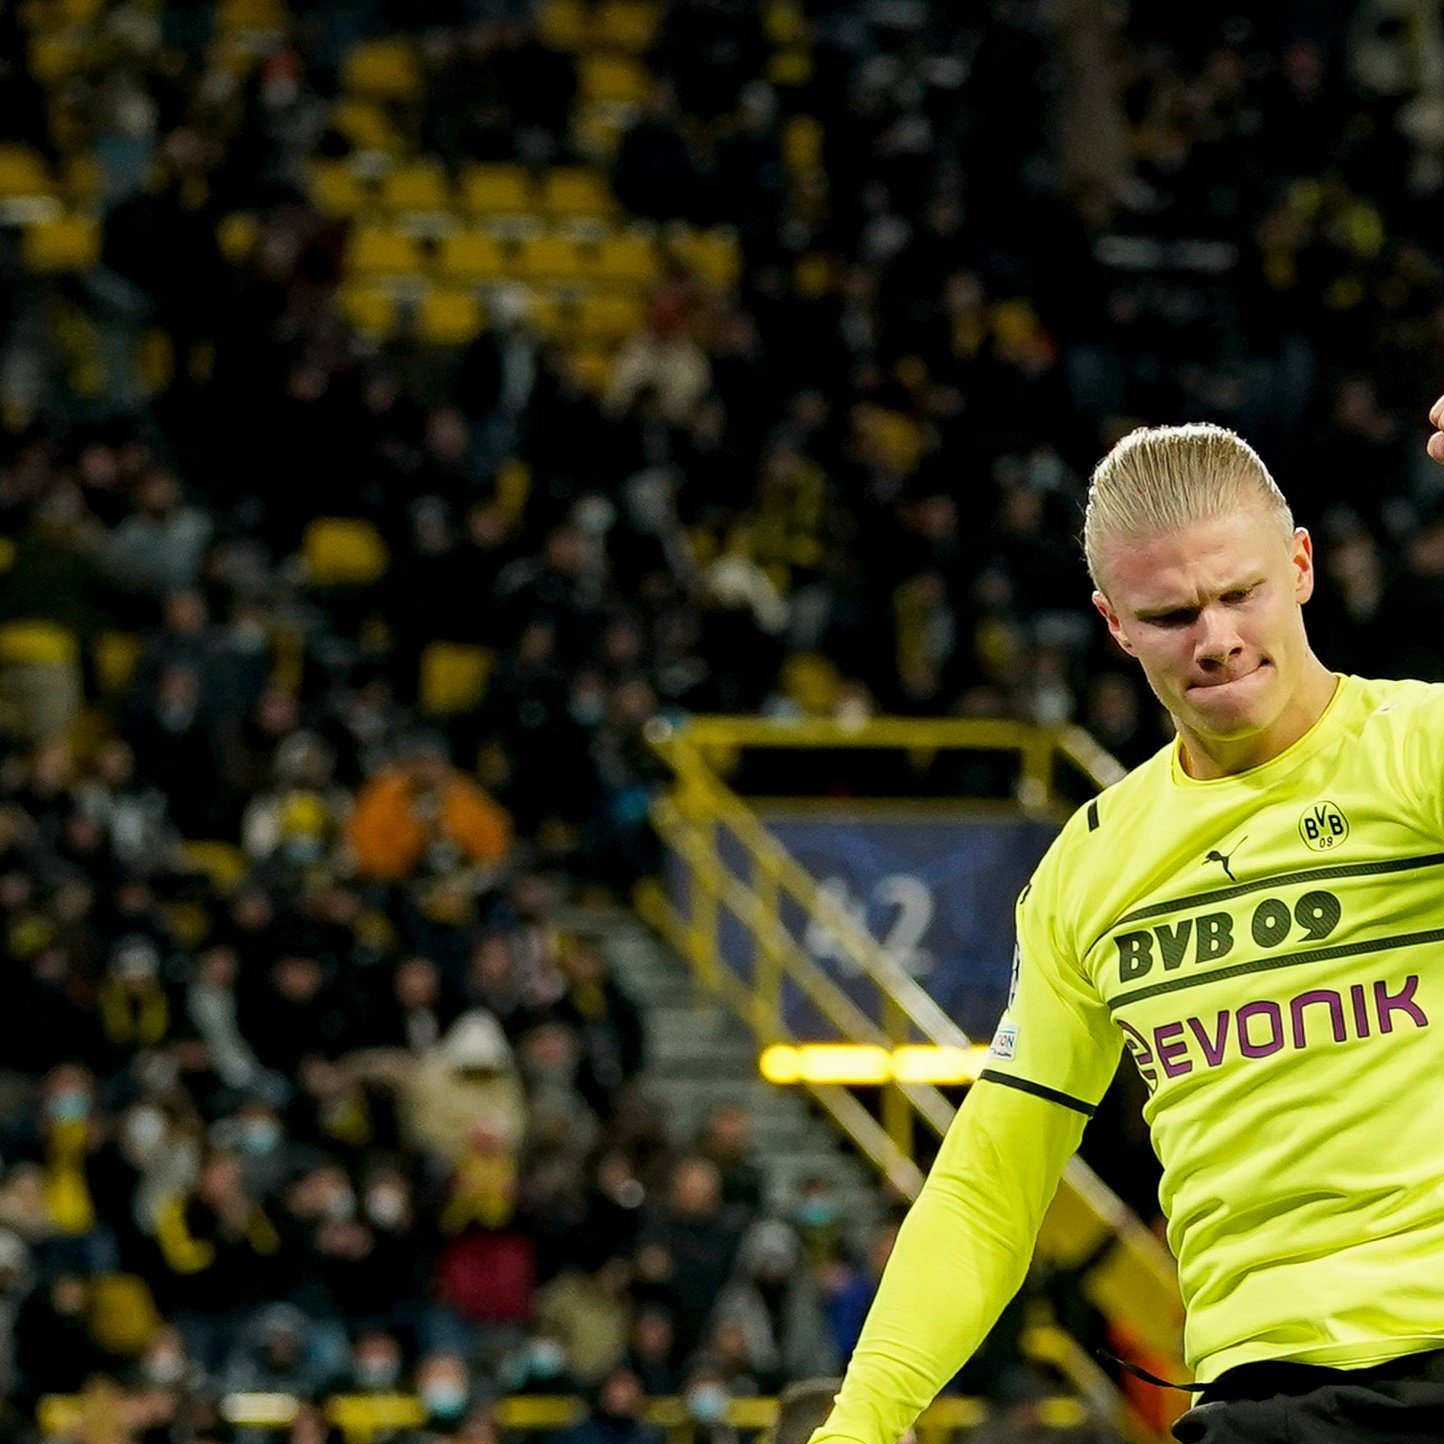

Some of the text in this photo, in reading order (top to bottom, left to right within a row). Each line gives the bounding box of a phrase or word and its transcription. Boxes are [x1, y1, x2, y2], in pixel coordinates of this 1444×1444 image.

[1304, 805, 1344, 840] BVB
[1319, 836, 1334, 849] 09
[1113, 890, 1342, 983] BVB 09
[1154, 975, 1428, 1079] EVONIK
